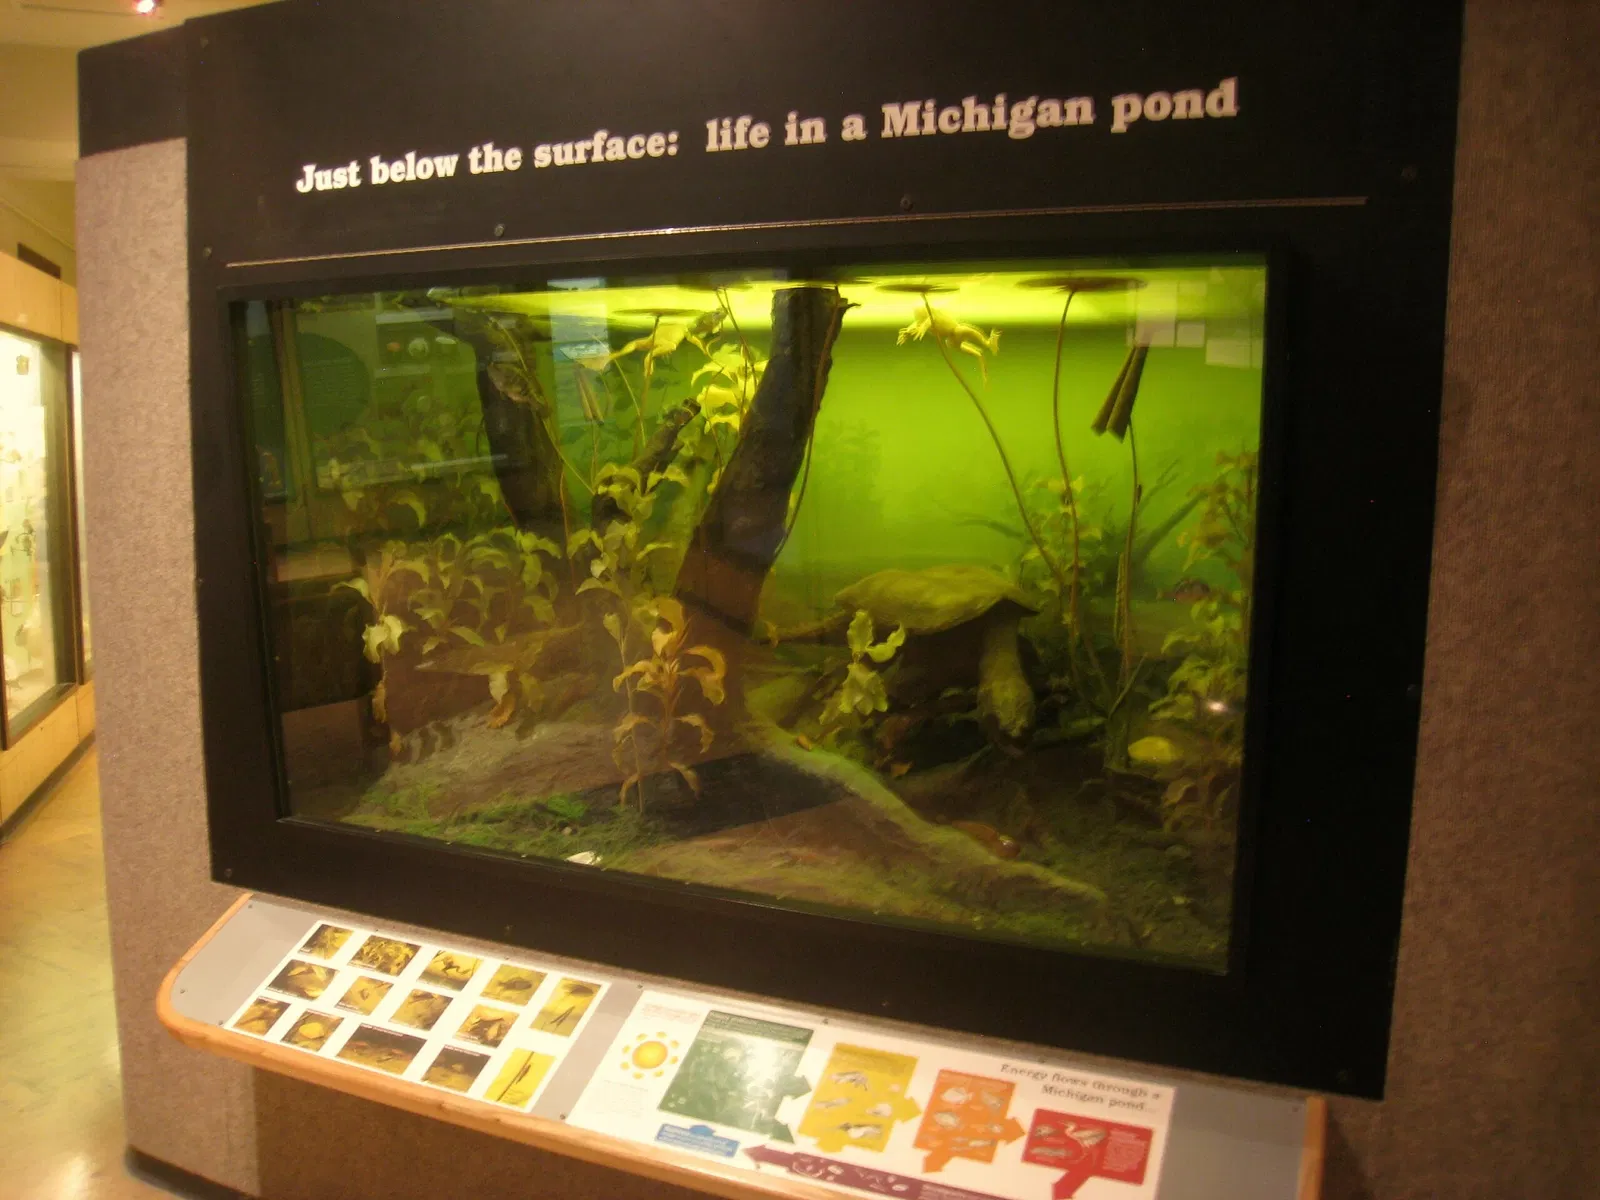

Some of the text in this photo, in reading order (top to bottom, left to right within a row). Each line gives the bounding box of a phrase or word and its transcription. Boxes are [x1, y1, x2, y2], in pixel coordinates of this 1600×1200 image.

[296, 76, 1239, 194] Just below the surface: life in a Michigan pond
[1000, 1063, 1048, 1081] Energy
[1051, 1072, 1089, 1087] flows
[1092, 1078, 1148, 1098] through
[1041, 1084, 1104, 1104] Michigan
